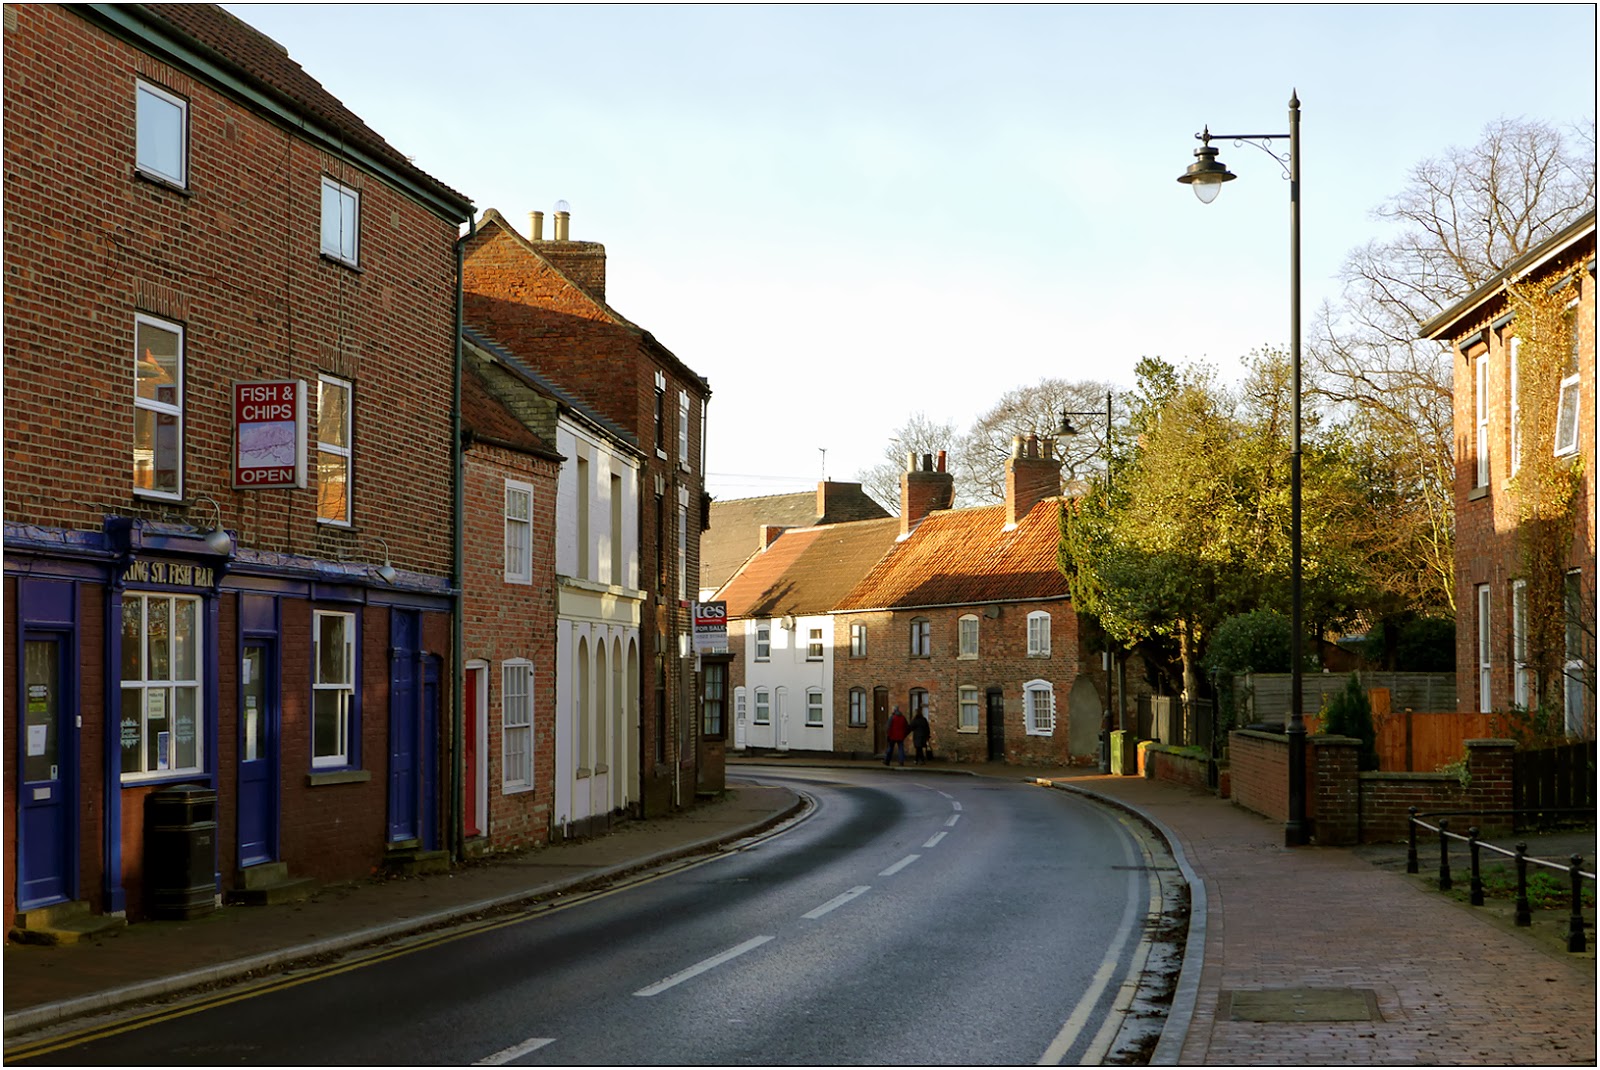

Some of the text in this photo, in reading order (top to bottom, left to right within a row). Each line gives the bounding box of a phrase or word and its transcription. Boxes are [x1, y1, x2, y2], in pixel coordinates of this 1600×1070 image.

[241, 386, 293, 402] FISH &
[242, 404, 292, 420] CHIPS
[241, 469, 293, 483] OPEN
[151, 562, 167, 584] ST.
[168, 563, 192, 585] FISH
[194, 566, 214, 587] BAR
[695, 604, 725, 618] tes
